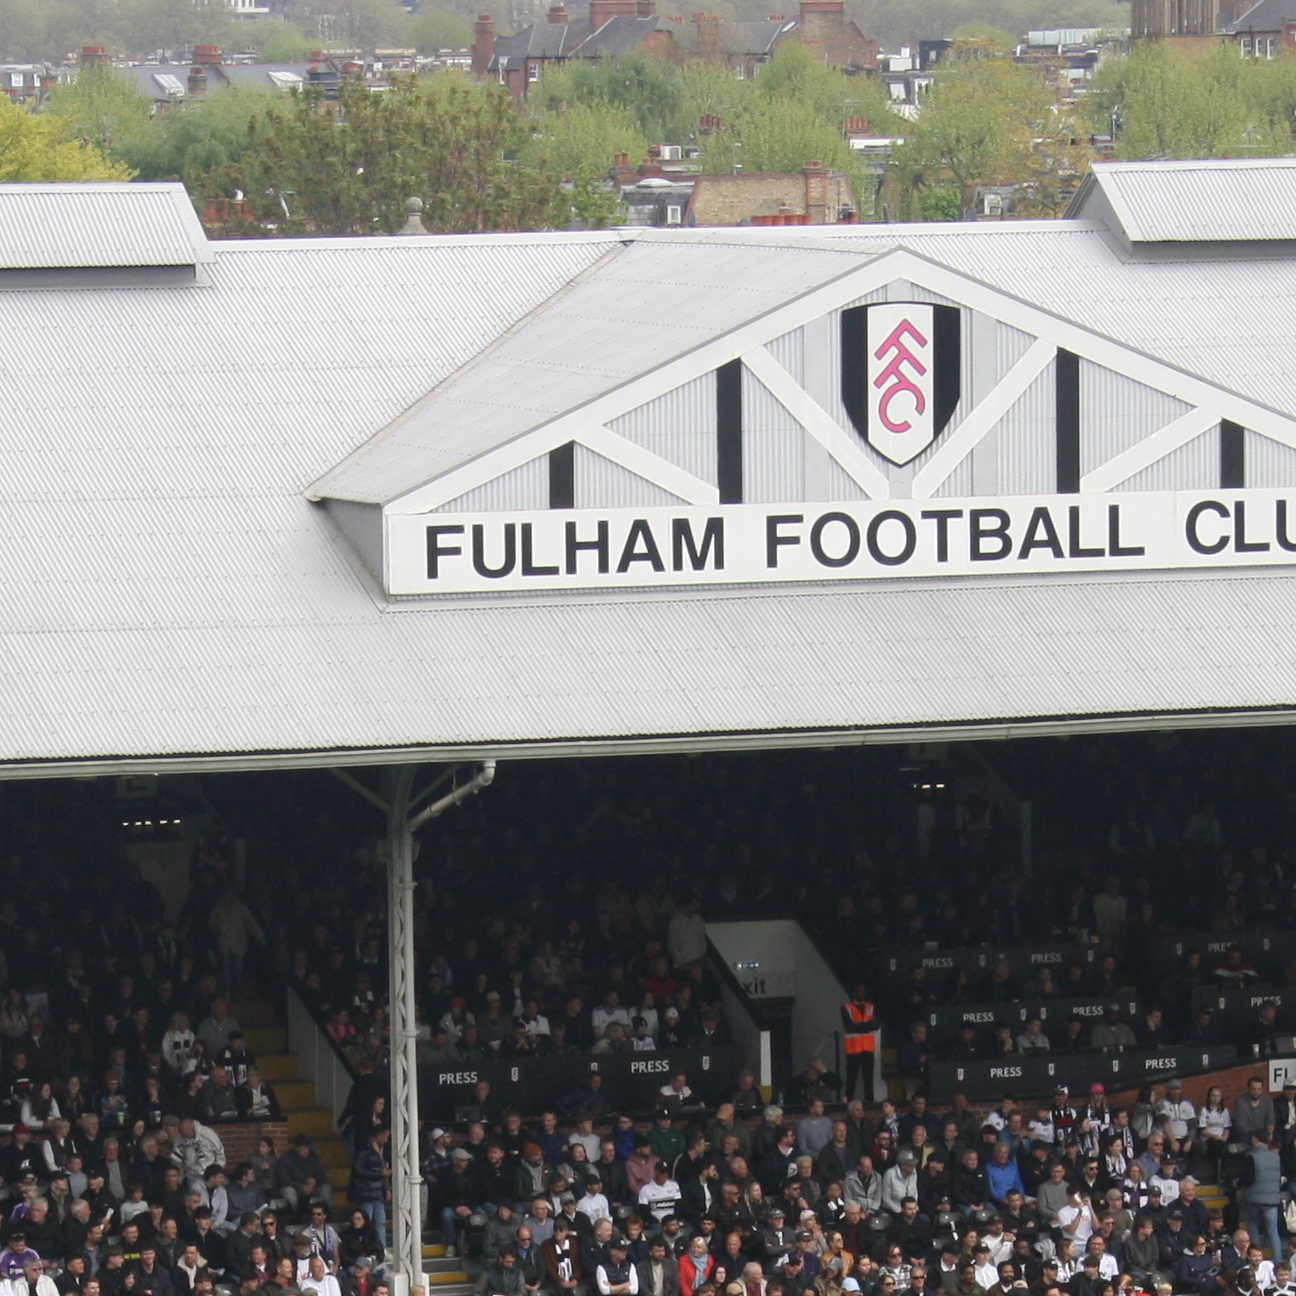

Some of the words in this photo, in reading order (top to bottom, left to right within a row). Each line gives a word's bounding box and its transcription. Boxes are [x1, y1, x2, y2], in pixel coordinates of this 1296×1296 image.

[425, 516, 726, 582] FULHAM
[766, 504, 1145, 569] FOOTBALL
[922, 957, 953, 969] PRESS
[1031, 952, 1062, 964] PRESS
[963, 1011, 994, 1023] PRESS
[631, 1059, 670, 1074] PRESS
[1145, 1057, 1177, 1070] PRESS
[990, 1066, 1022, 1078] PRESS
[439, 1071, 478, 1086] PRESS
